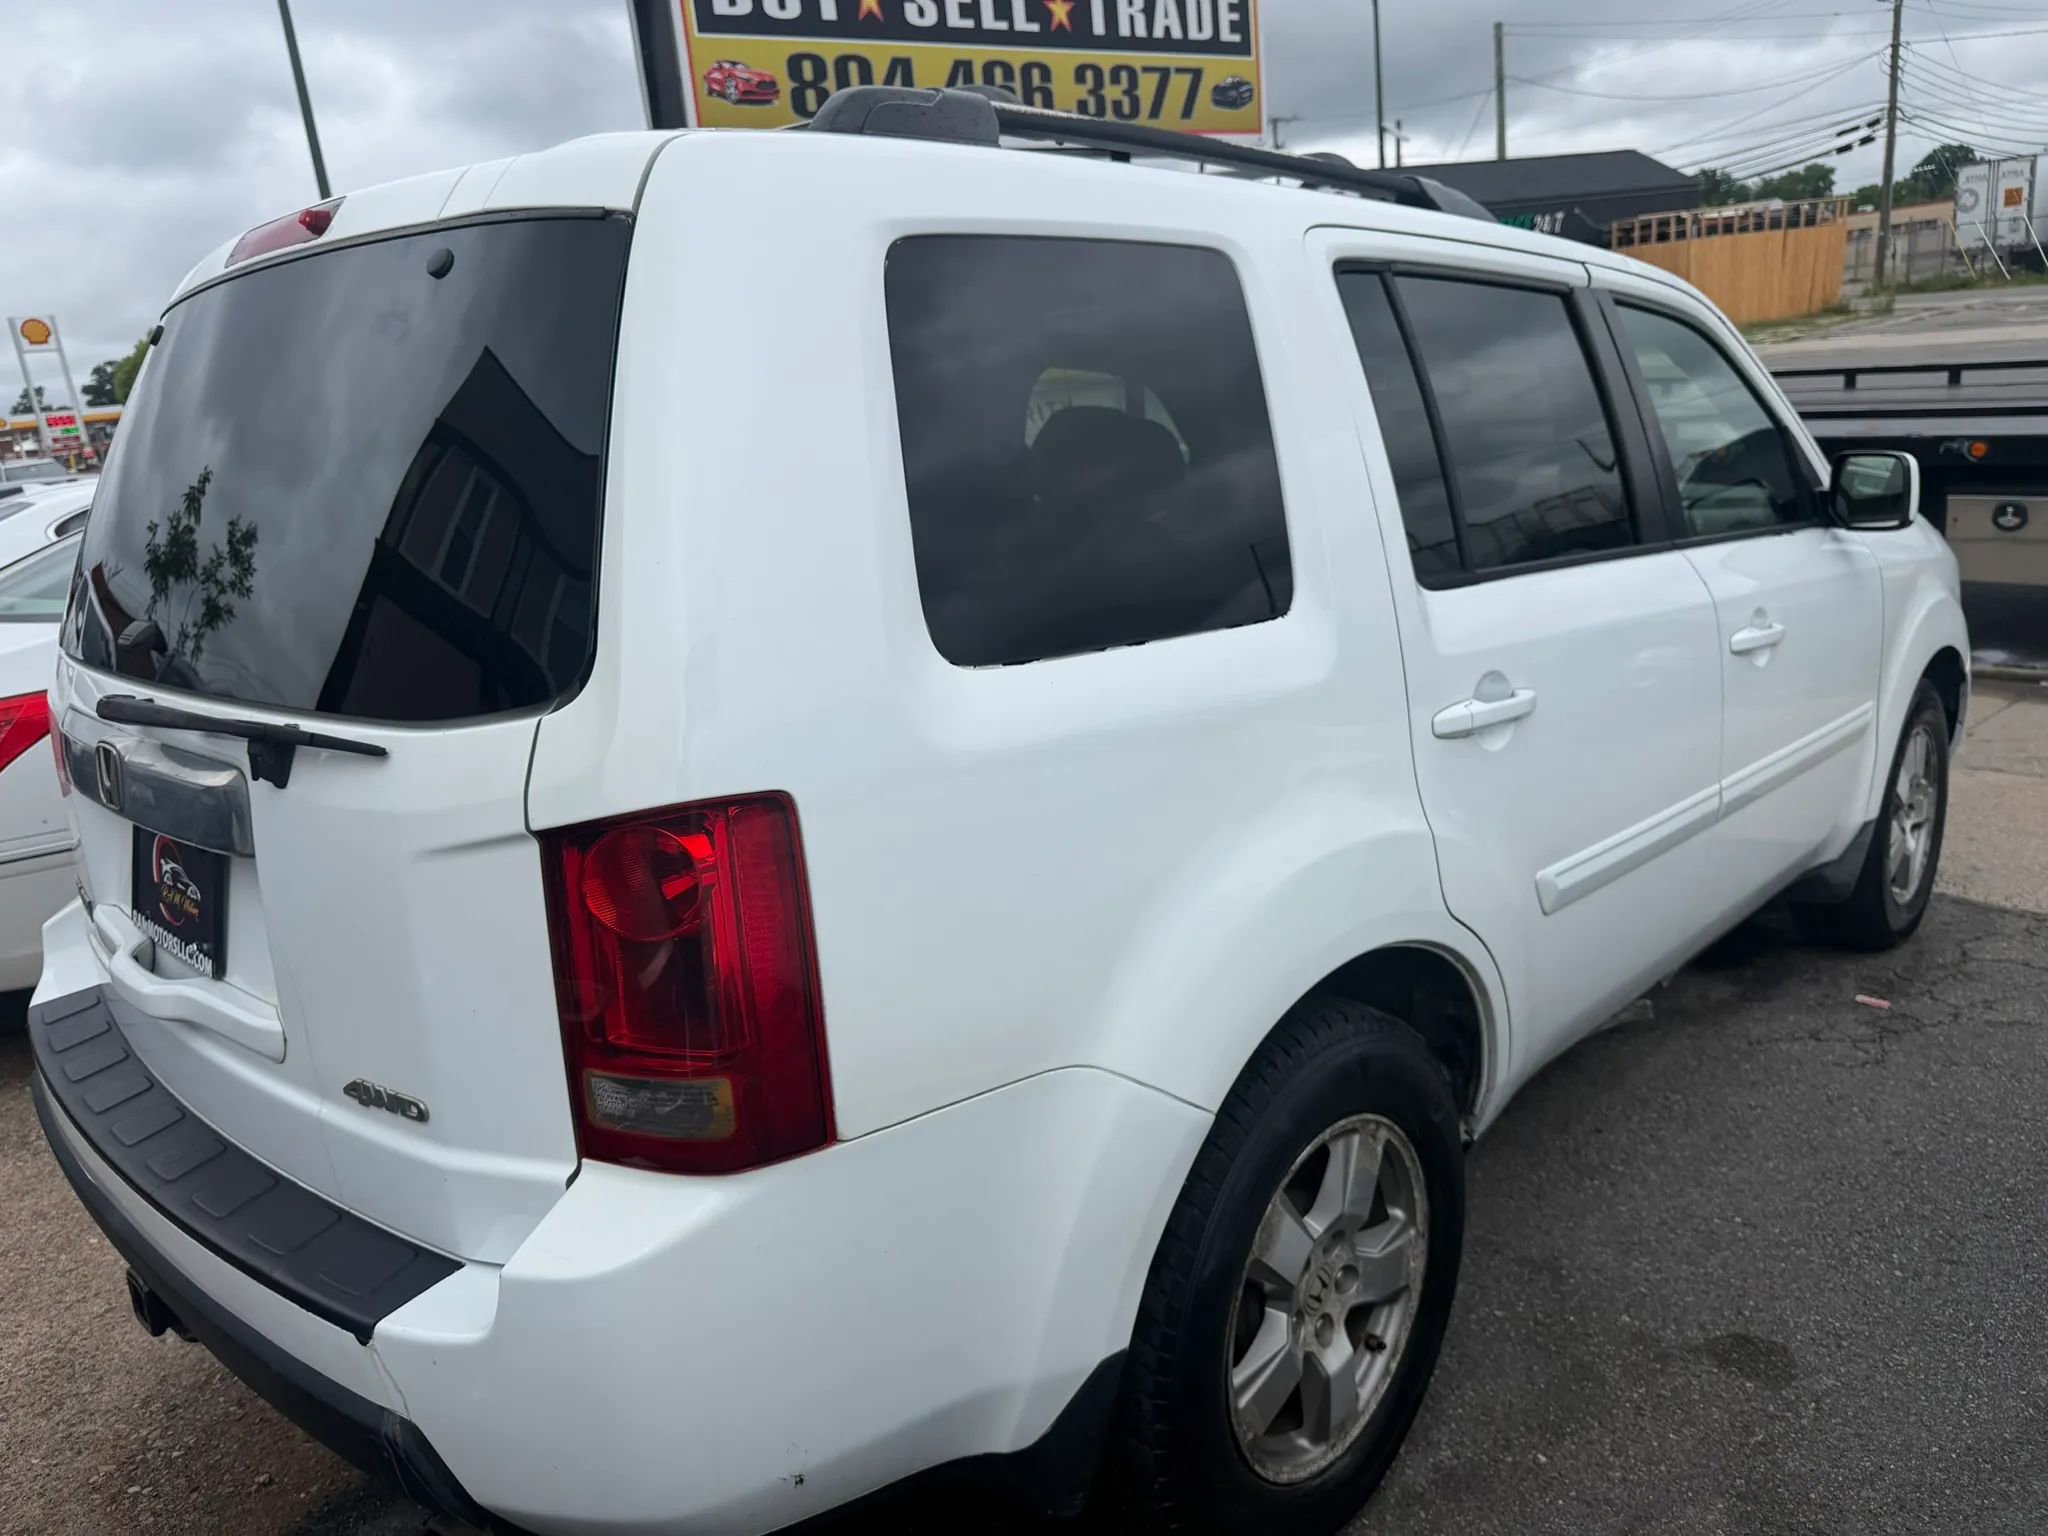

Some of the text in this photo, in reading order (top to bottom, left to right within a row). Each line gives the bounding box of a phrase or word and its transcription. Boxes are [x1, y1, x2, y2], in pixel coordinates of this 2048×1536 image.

[903, 0, 1243, 43] SELL TRADE
[343, 1078, 430, 1122] 4WD
